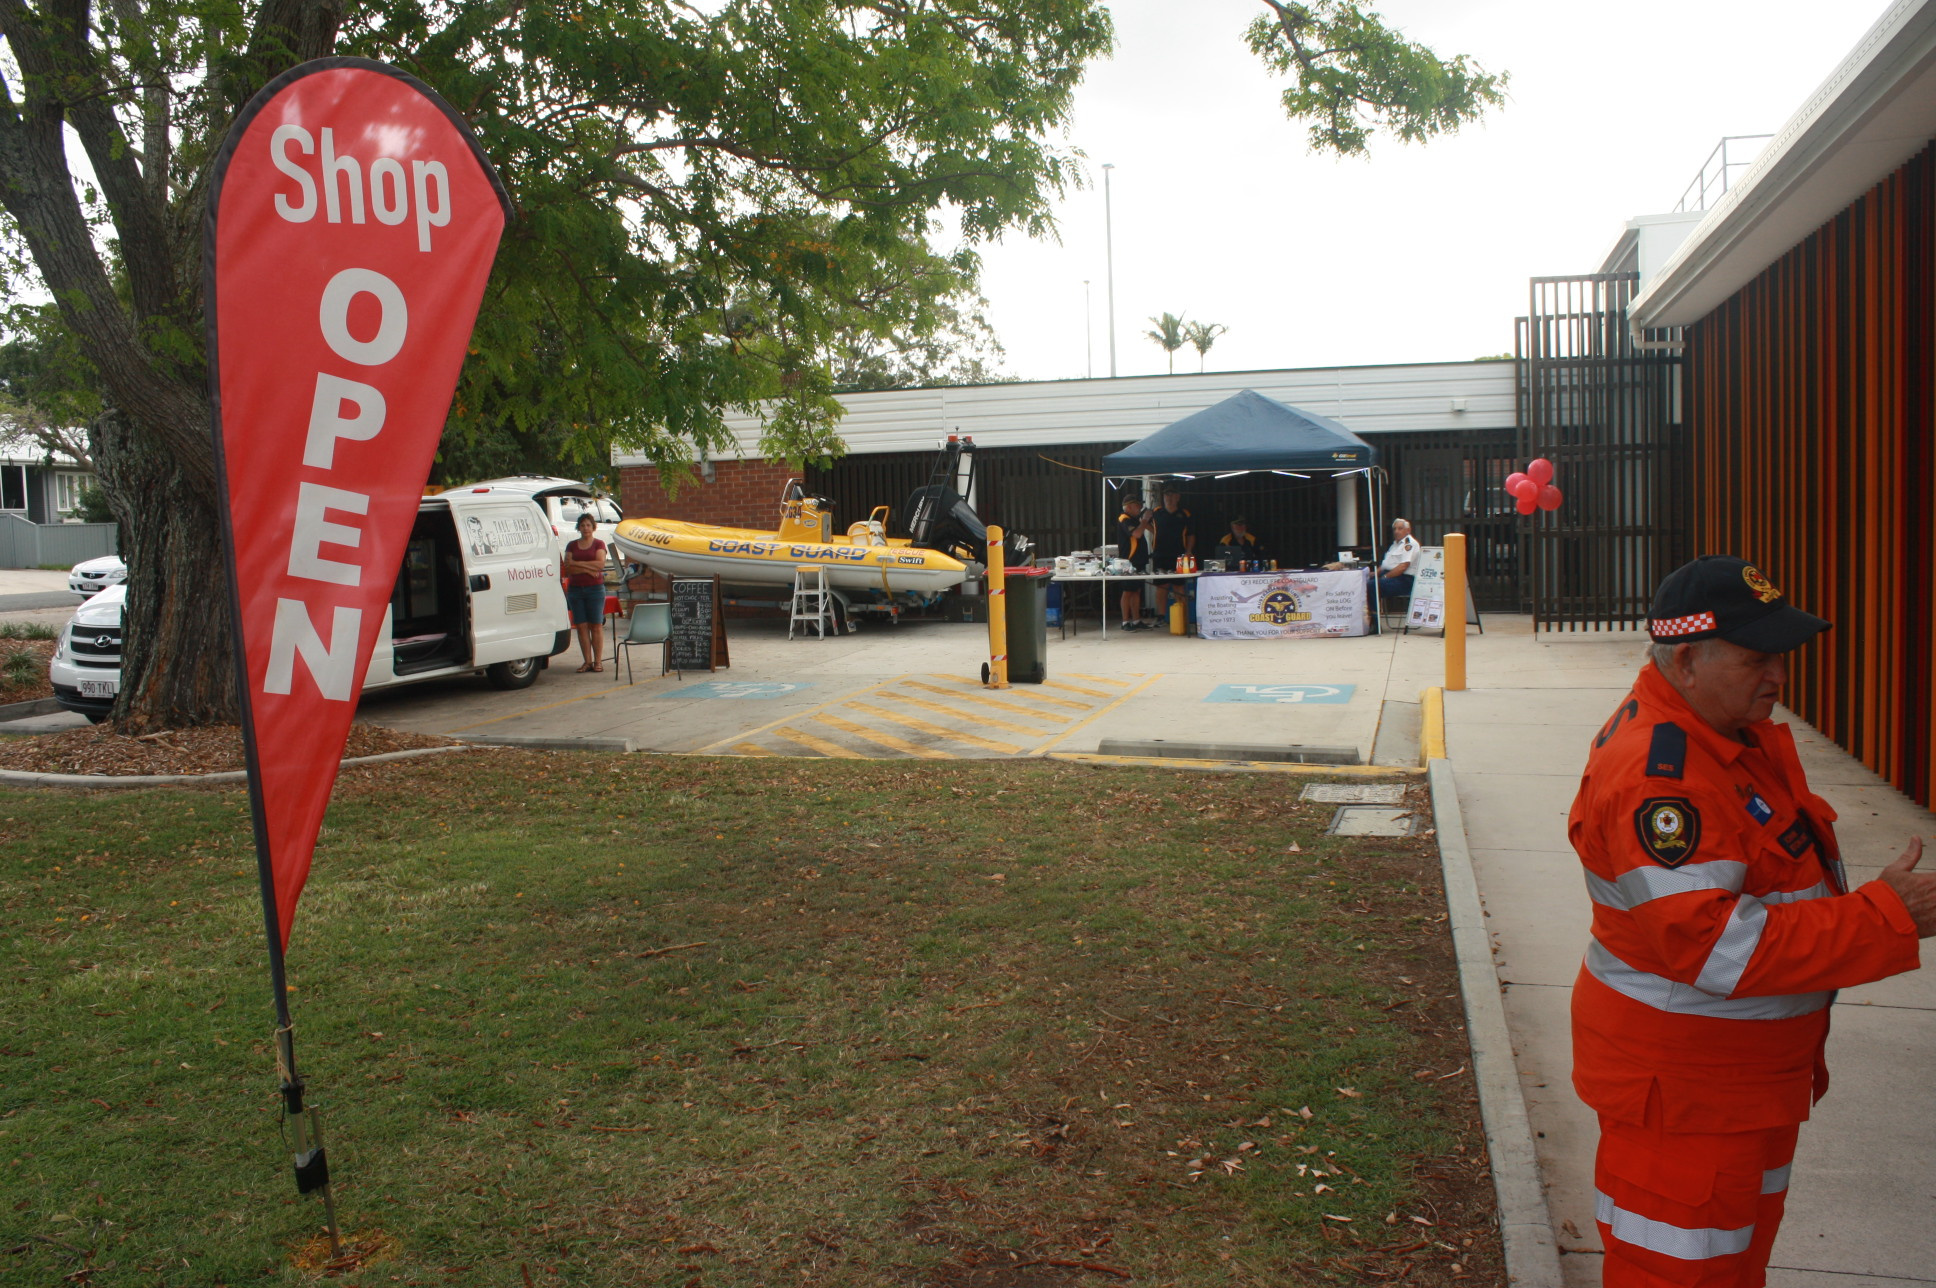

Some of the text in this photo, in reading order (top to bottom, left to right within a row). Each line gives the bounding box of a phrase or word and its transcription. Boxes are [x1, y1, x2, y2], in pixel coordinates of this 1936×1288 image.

[270, 124, 451, 252] Shop
[263, 268, 408, 702] OPEN
[628, 526, 674, 545] 31515QC
[708, 539, 867, 561] COAST GUARD
[507, 566, 544, 581] Mobile
[672, 583, 710, 594] COFFEE
[1249, 612, 1312, 623] COAST GUARD
[82, 682, 112, 694] 990 TKL
[1657, 763, 1675, 772] SES
